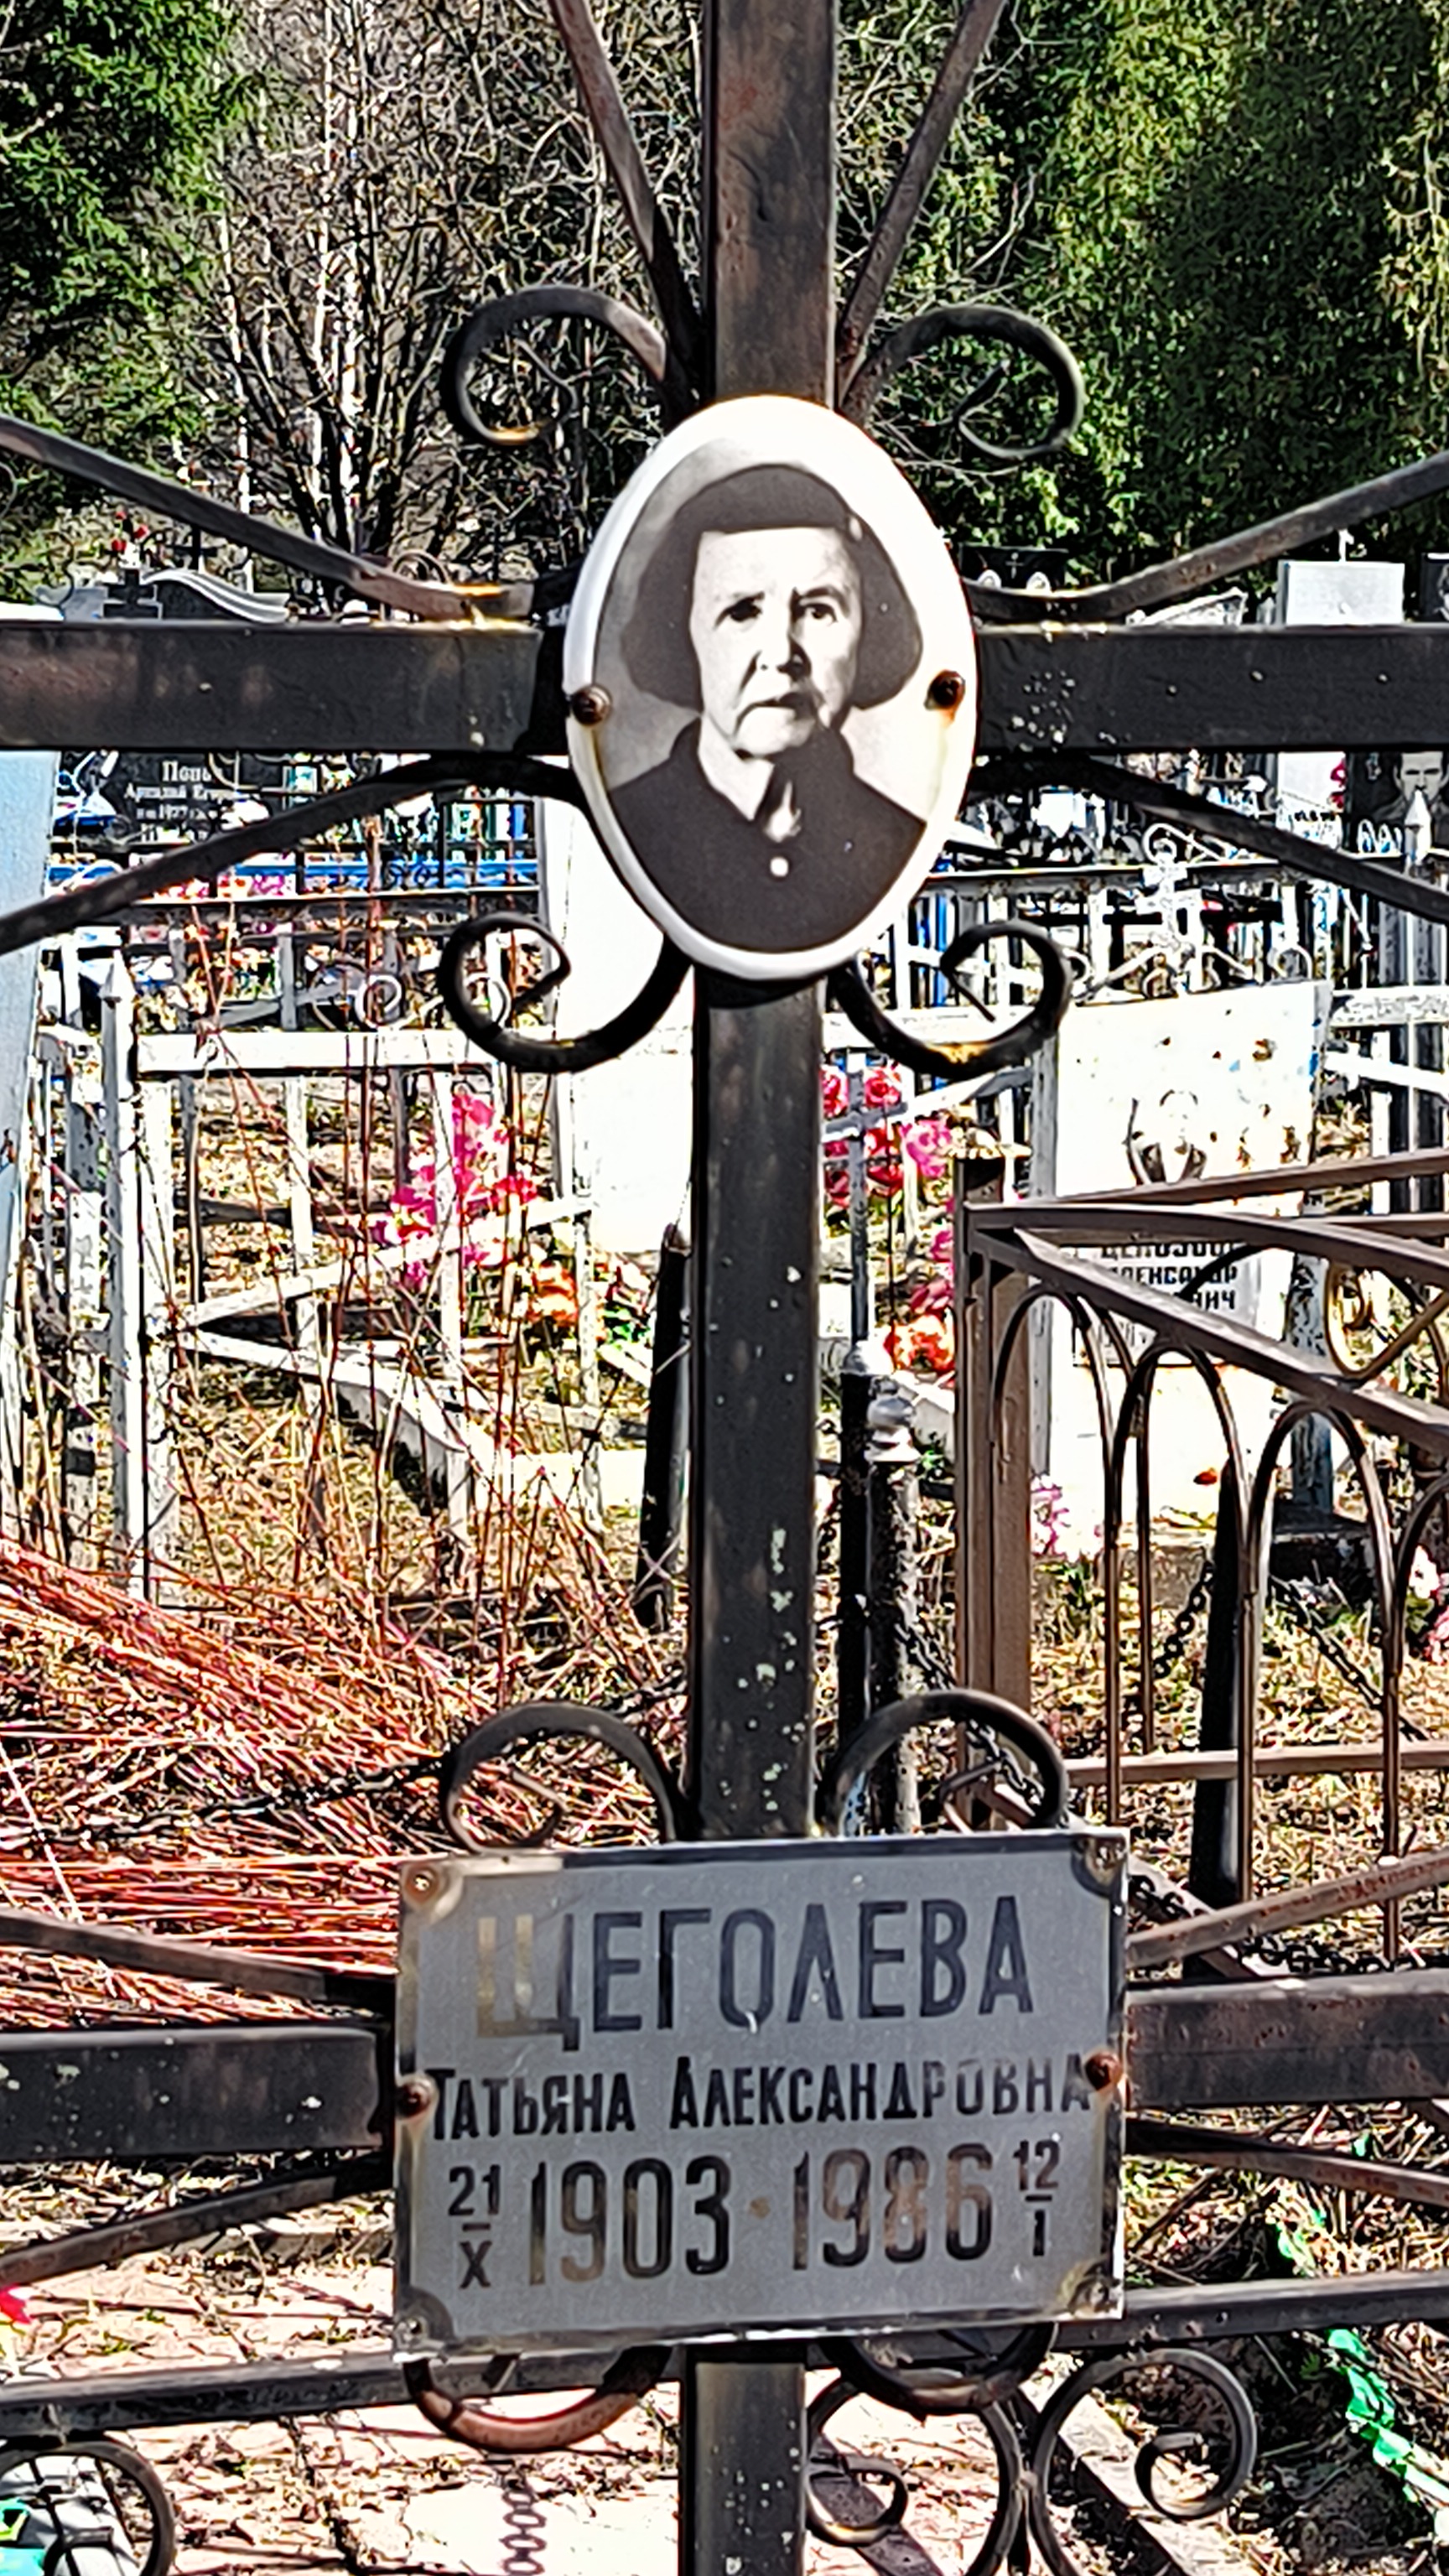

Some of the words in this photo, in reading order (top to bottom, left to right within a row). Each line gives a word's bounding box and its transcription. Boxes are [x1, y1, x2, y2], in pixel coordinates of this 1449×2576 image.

[477, 1895, 1035, 2052] ЩЕГОЛЕВА
[448, 2163, 501, 2217] 21
[529, 2154, 732, 2286] 1903
[792, 2142, 994, 2271] 1986
[1012, 2139, 1061, 2193] 12
